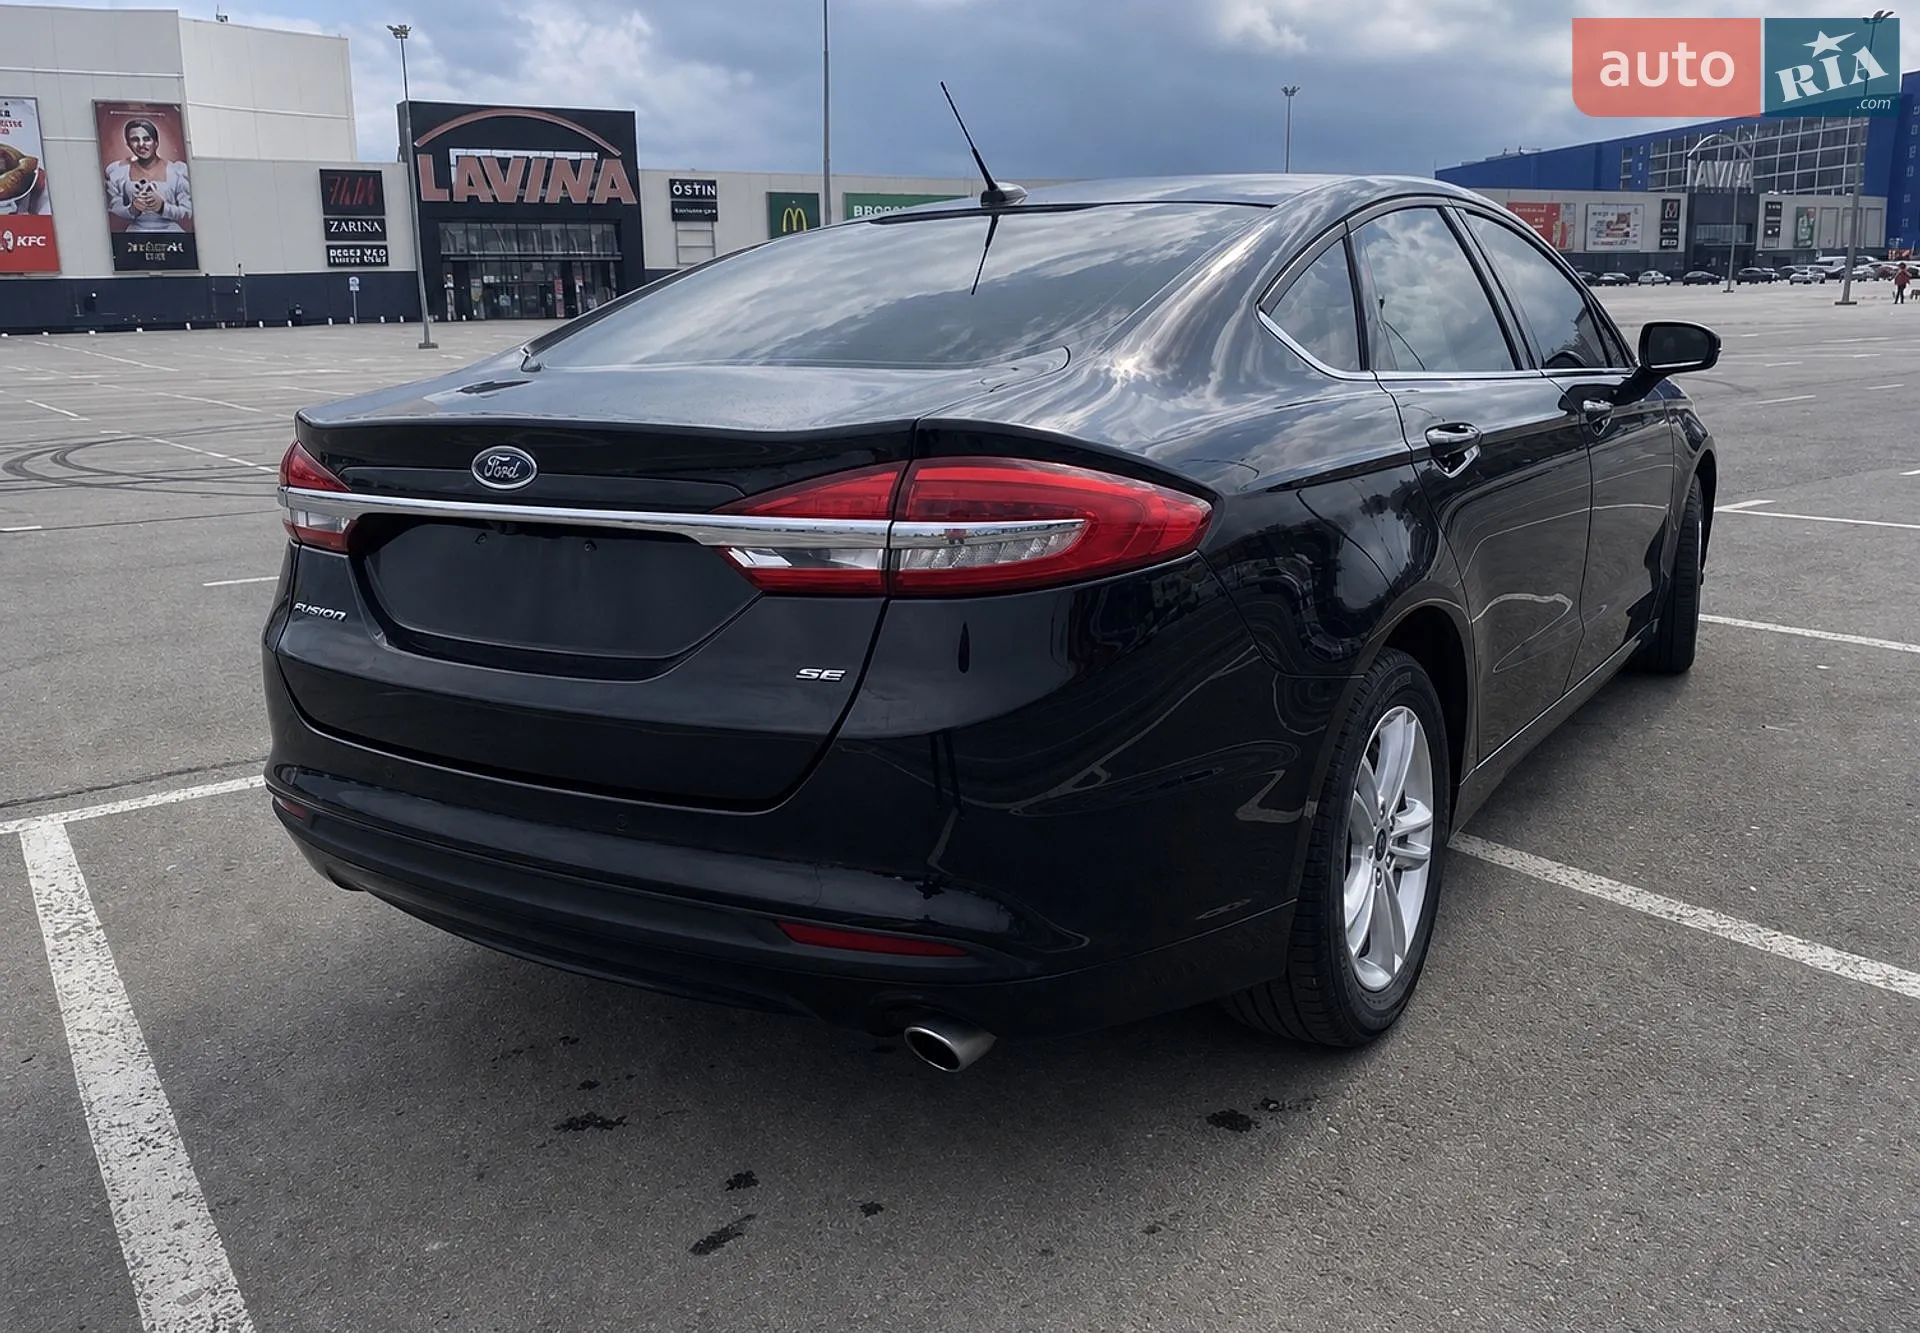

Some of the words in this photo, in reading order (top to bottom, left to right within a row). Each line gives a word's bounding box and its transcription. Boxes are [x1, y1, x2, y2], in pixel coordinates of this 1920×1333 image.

[417, 153, 637, 204] LAVINA
[329, 220, 382, 233] ZARINA
[17, 235, 47, 247] KFC
[484, 455, 521, 479] Ford
[795, 668, 846, 681] SE
